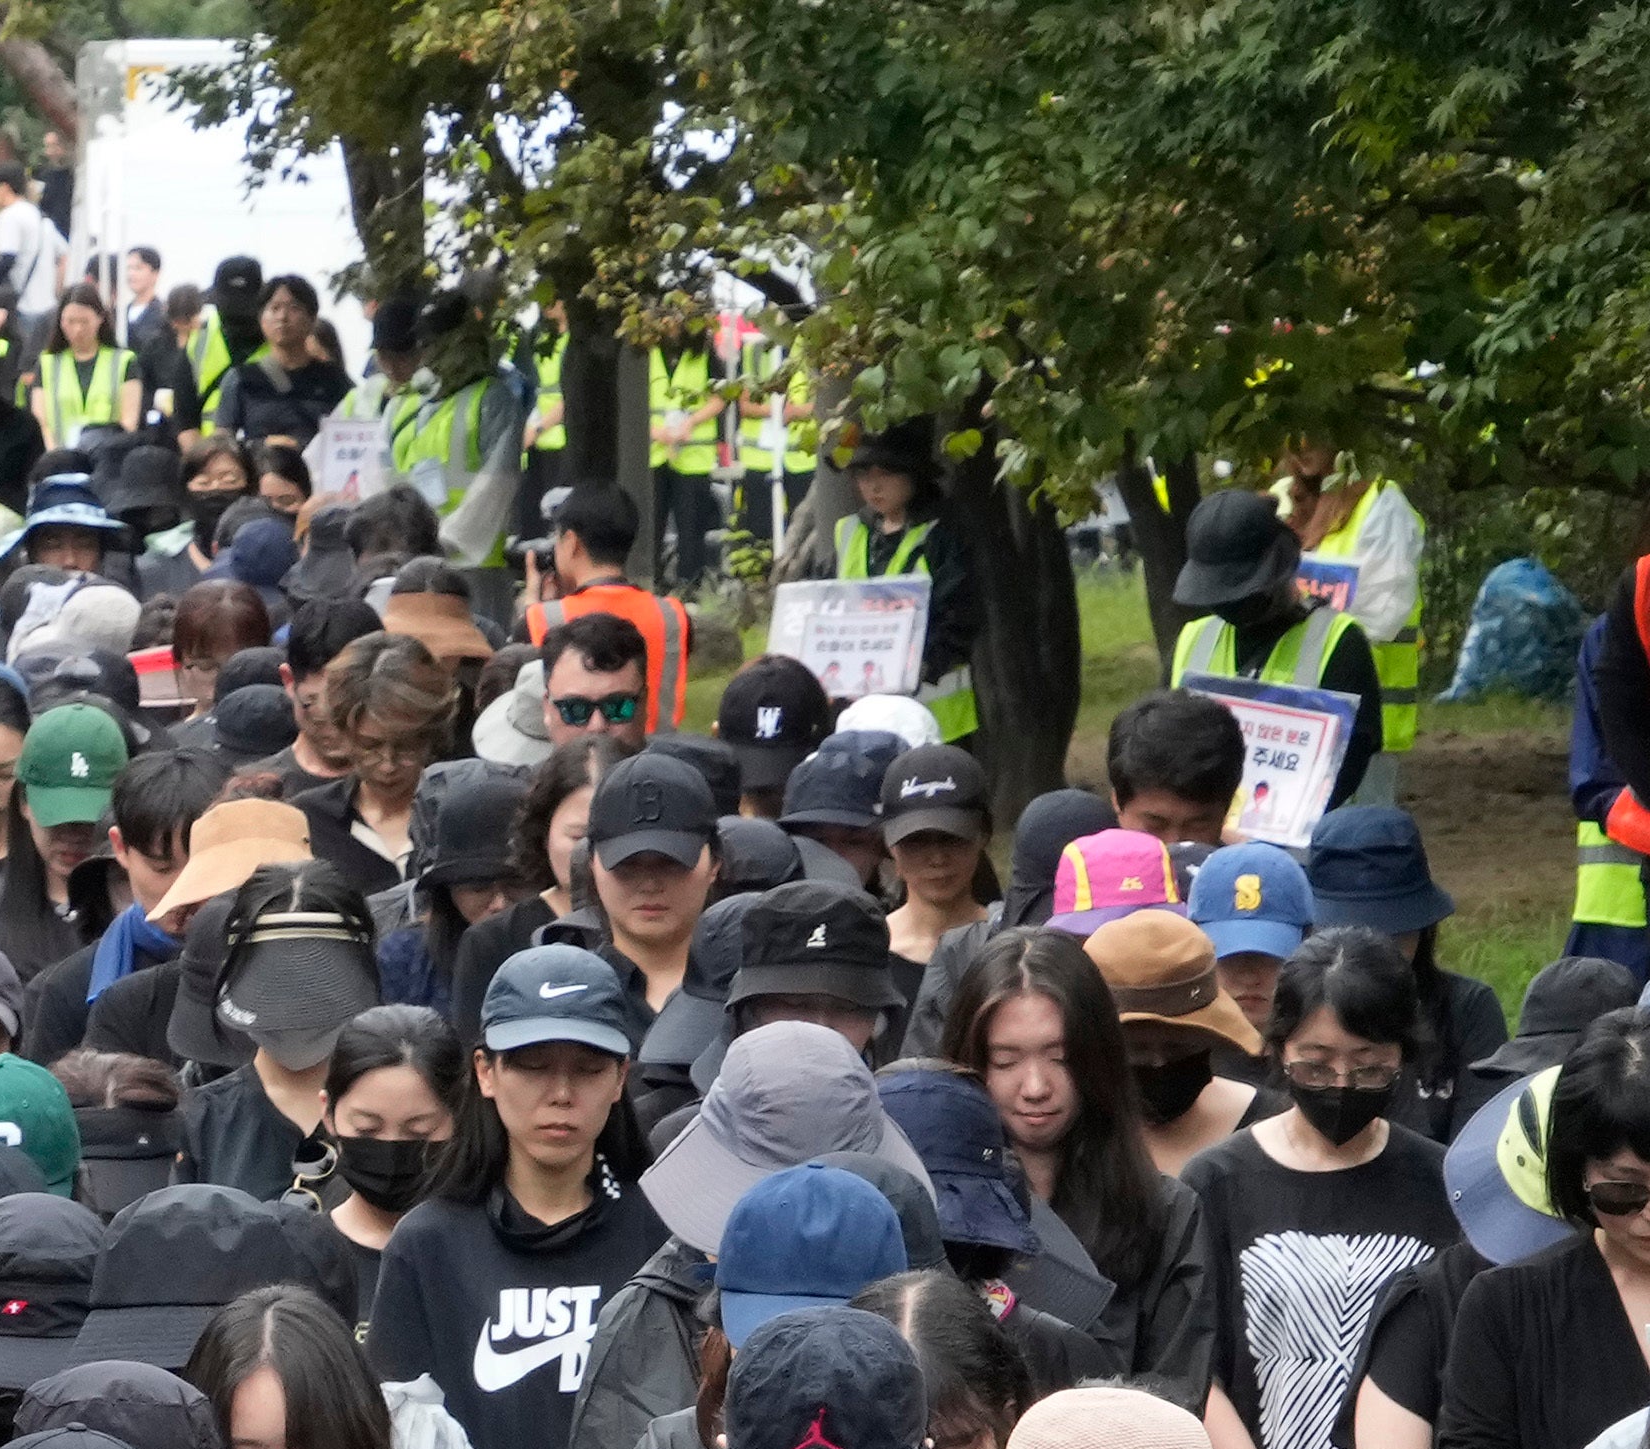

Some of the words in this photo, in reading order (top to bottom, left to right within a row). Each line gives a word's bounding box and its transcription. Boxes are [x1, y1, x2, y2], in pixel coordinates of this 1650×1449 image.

[1234, 874, 1261, 910] S
[491, 1285, 601, 1342] JUST
[558, 1340, 595, 1393] D
